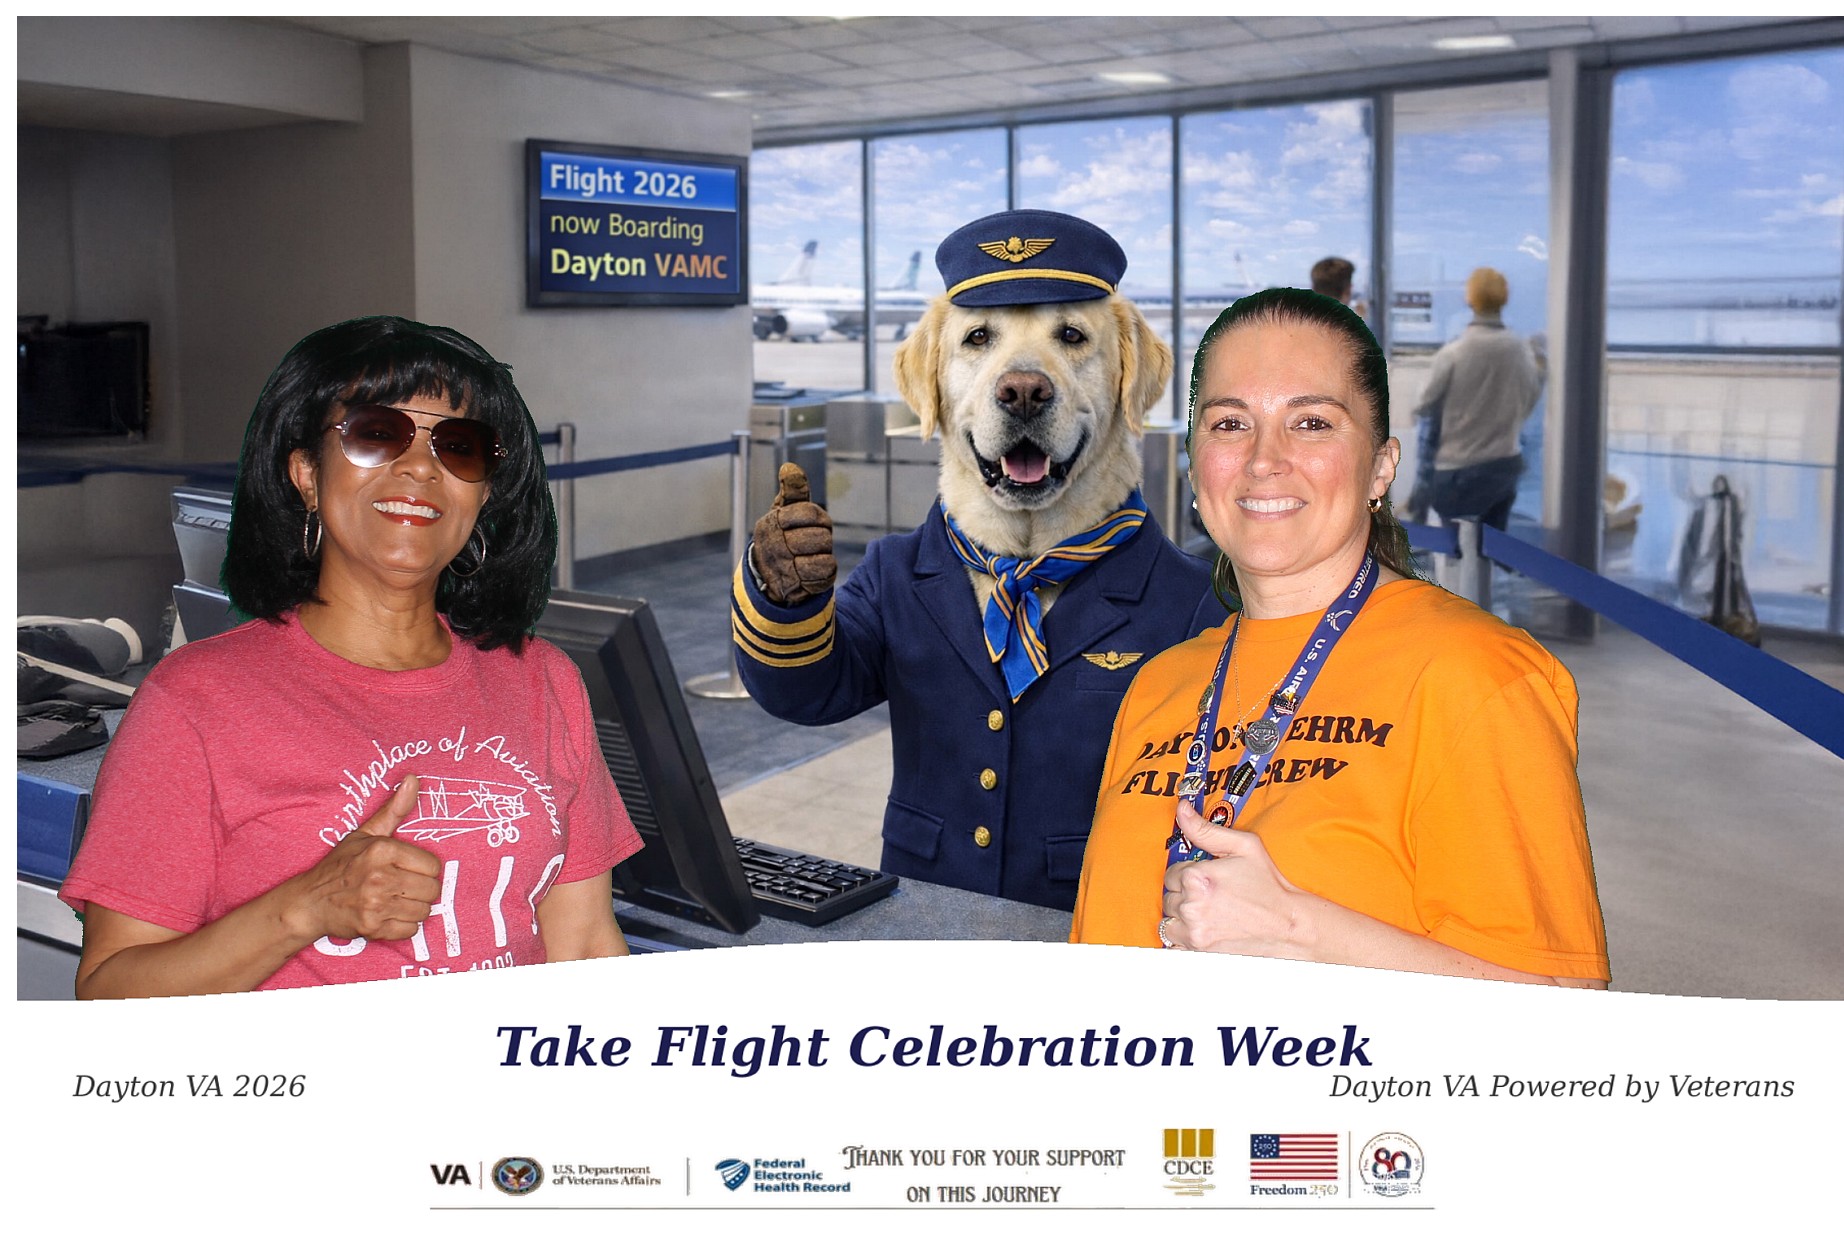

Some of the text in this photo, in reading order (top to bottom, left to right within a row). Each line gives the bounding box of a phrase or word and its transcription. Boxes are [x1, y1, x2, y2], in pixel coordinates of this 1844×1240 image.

[550, 164, 697, 199] Flight 2026
[550, 213, 704, 246] now Boarding
[551, 248, 728, 281] Dayton VAMC
[1304, 637, 1327, 664] U.S.
[1137, 722, 1254, 760] DAYO
[1285, 715, 1394, 748] EHRM
[438, 726, 469, 762] of
[474, 735, 561, 840] Aviation
[1121, 765, 1238, 797] FLIHT
[313, 853, 565, 962] HIO
